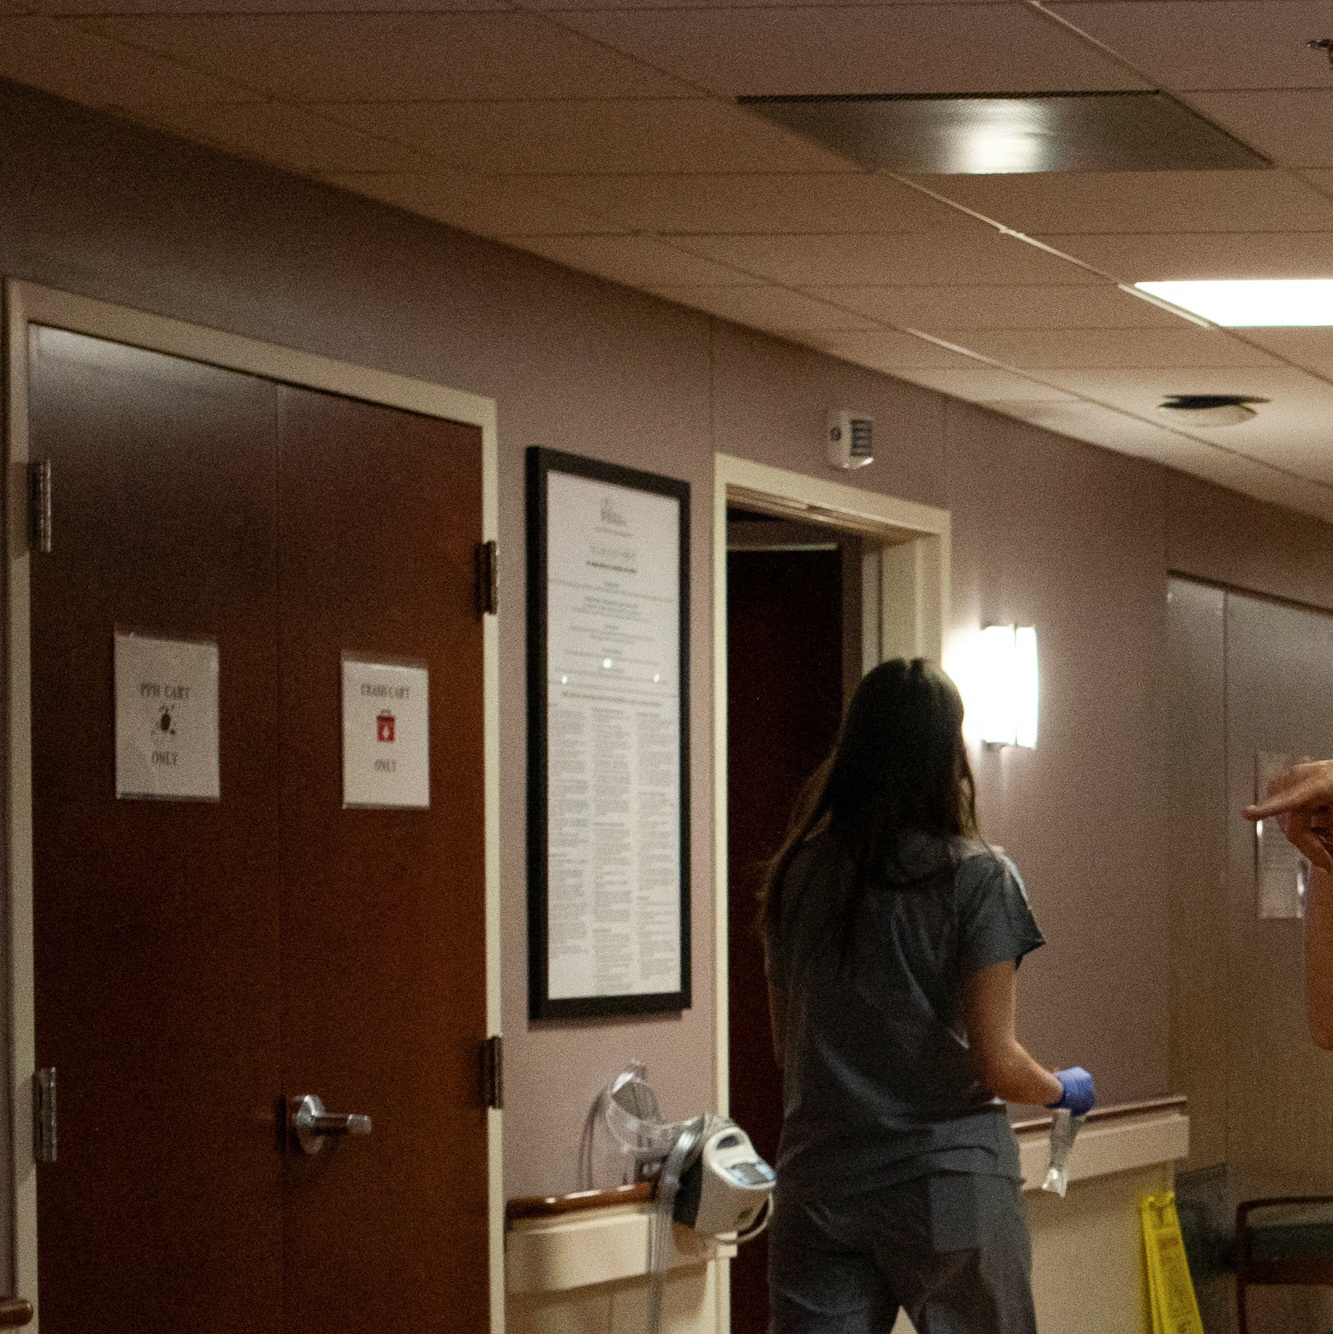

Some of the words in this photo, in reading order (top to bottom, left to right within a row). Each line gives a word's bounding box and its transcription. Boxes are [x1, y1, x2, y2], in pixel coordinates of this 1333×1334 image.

[164, 685, 191, 699] CART
[389, 686, 410, 700] CART
[152, 750, 178, 766] ONLY
[374, 758, 397, 774] ONLY
